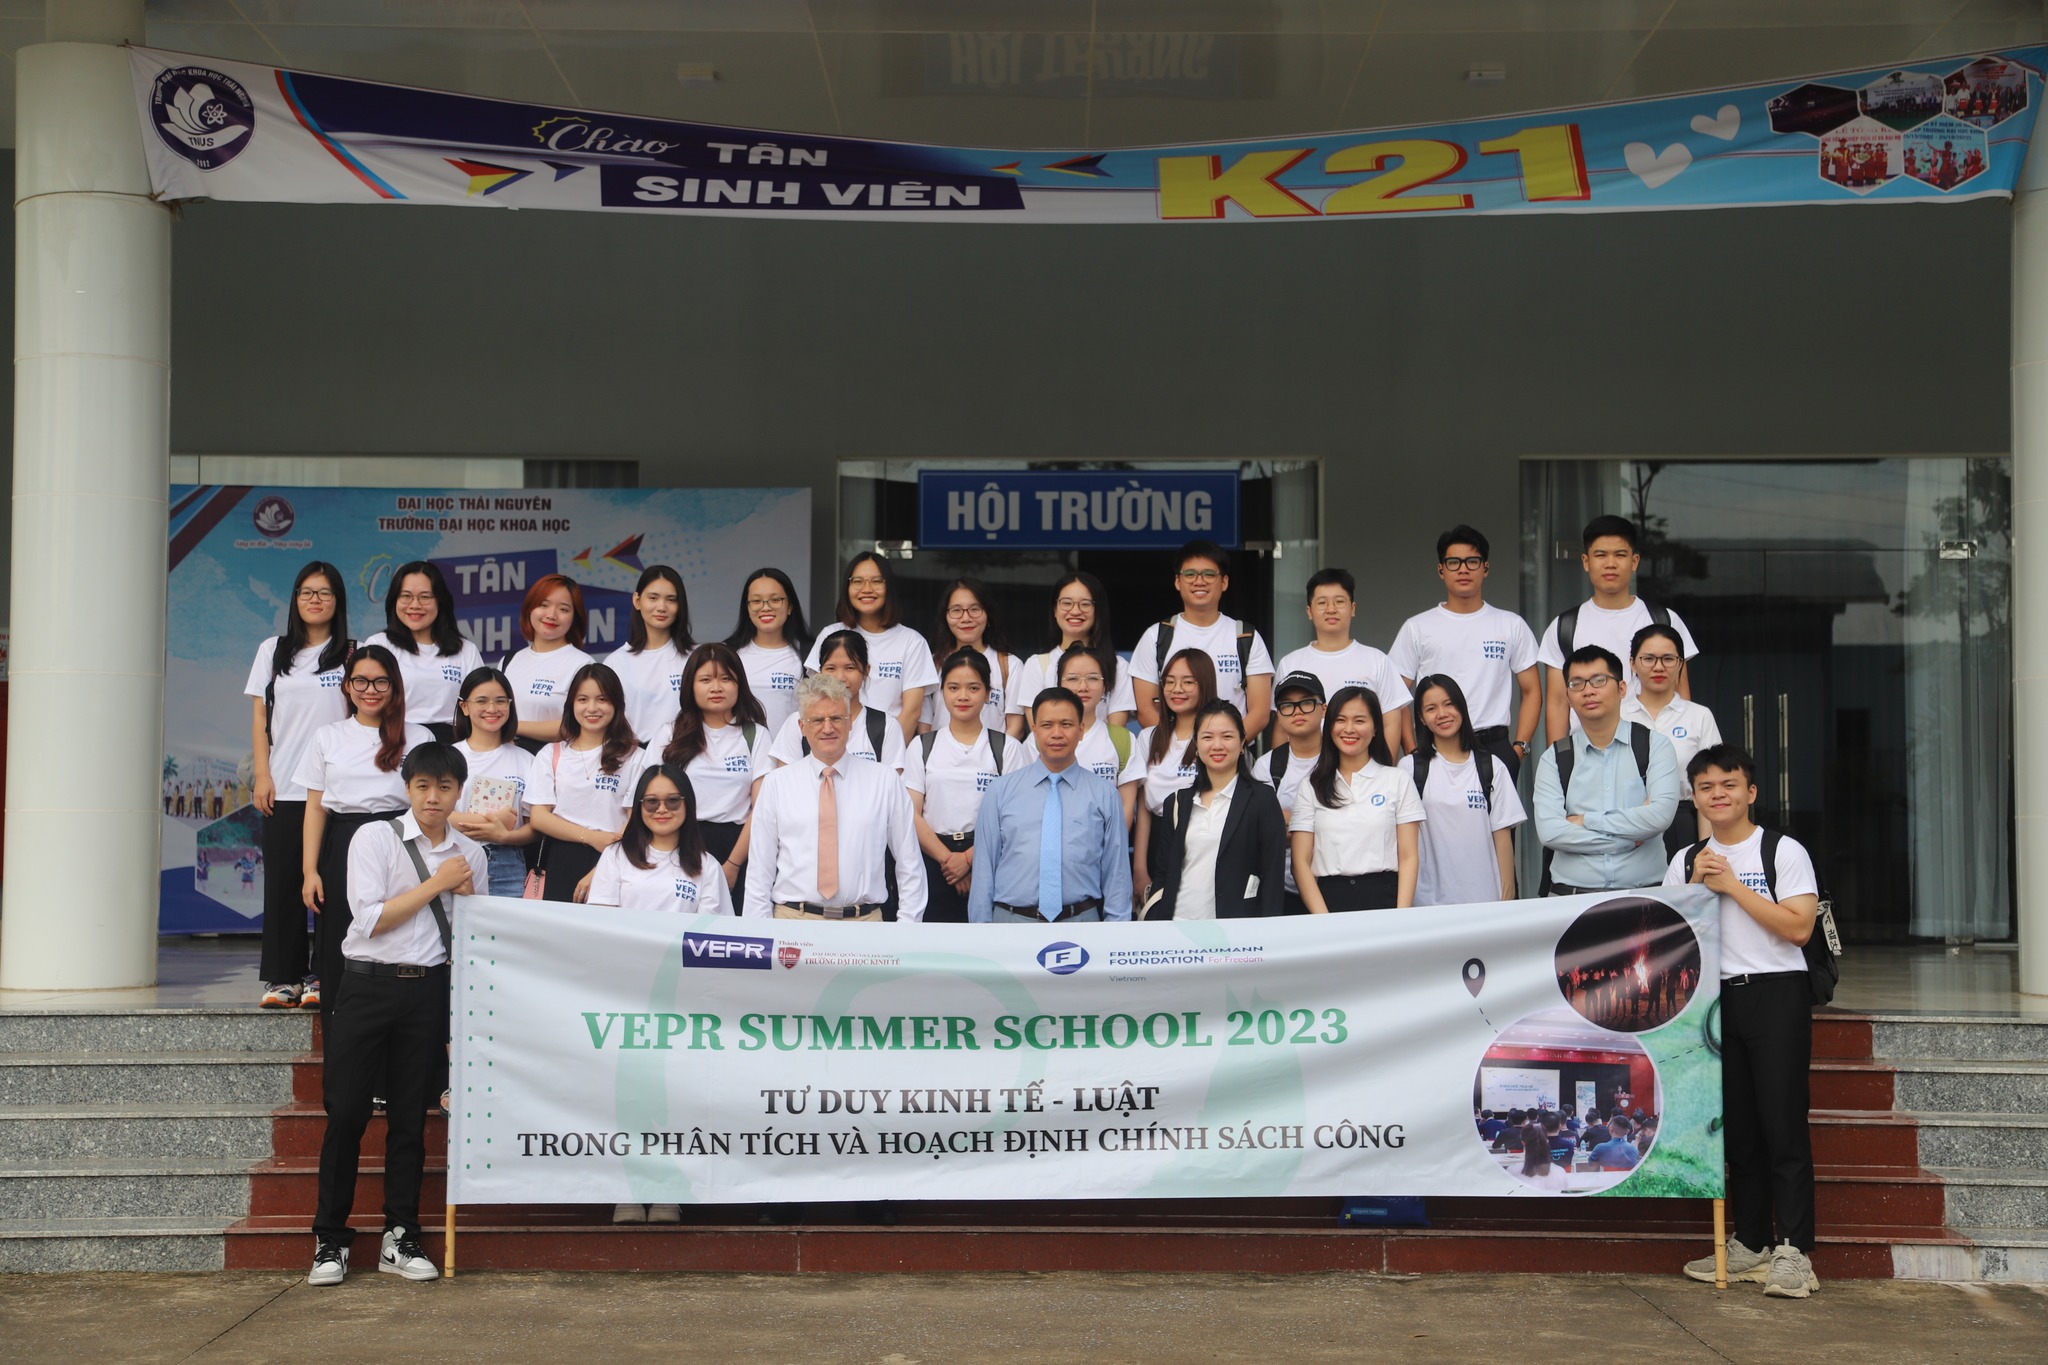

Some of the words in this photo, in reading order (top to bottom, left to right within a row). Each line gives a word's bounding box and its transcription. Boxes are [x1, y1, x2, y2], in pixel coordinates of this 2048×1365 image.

[188, 136, 214, 147] TNUS
[548, 121, 680, 154] Chào
[707, 141, 828, 167] TÂN
[1154, 123, 1591, 220] K21
[633, 175, 801, 205] SINH
[820, 181, 981, 207] VIÊN
[398, 497, 421, 512] ĐẠI
[426, 498, 454, 513] HỌC
[459, 496, 490, 511] THÁI
[494, 496, 552, 511] NGUYÊN
[948, 482, 1020, 540] HỘI
[1035, 480, 1212, 532] TRƯỜNG
[379, 517, 434, 531] TRƯỜNG
[439, 518, 463, 533] ĐẠI
[467, 518, 495, 534] HỌC
[500, 518, 538, 531] KHOA
[542, 519, 570, 534] HỌC
[455, 557, 526, 595] TÂN
[457, 616, 512, 652] NH
[1483, 645, 1506, 655] VEPR
[879, 665, 902, 675] VEPR
[532, 682, 553, 692] VEPR
[771, 676, 794, 686] VEPR
[595, 777, 619, 788] VEPR
[675, 883, 697, 898] VEPR
[687, 938, 766, 959] VEPR
[1109, 949, 1185, 958] FRIEDRICH
[1188, 945, 1264, 955] NAUMANN
[1109, 955, 1204, 966] FOUNDATION
[1208, 956, 1223, 964] For
[582, 1012, 725, 1051] VEPR
[738, 1012, 981, 1052] SUMMER
[994, 1011, 1213, 1051] SCHOOL
[1227, 1008, 1348, 1046] 2023
[760, 1085, 813, 1115] TƯ
[818, 1088, 891, 1115] DUY
[899, 1087, 992, 1114] KINH
[1000, 1079, 1046, 1113] TẾ
[1073, 1080, 1160, 1117] LUẬT
[517, 1132, 632, 1157] TRONG
[640, 1127, 732, 1156] PHÂN
[740, 1127, 820, 1156] TÍCH
[828, 1126, 869, 1155] VÀ
[878, 1131, 994, 1160] HOẠCH
[1003, 1128, 1089, 1159] ĐỊNH
[1099, 1122, 1208, 1151] CHÍNH
[1217, 1119, 1304, 1150] SÁCH
[1313, 1118, 1406, 1149] CÔNG
